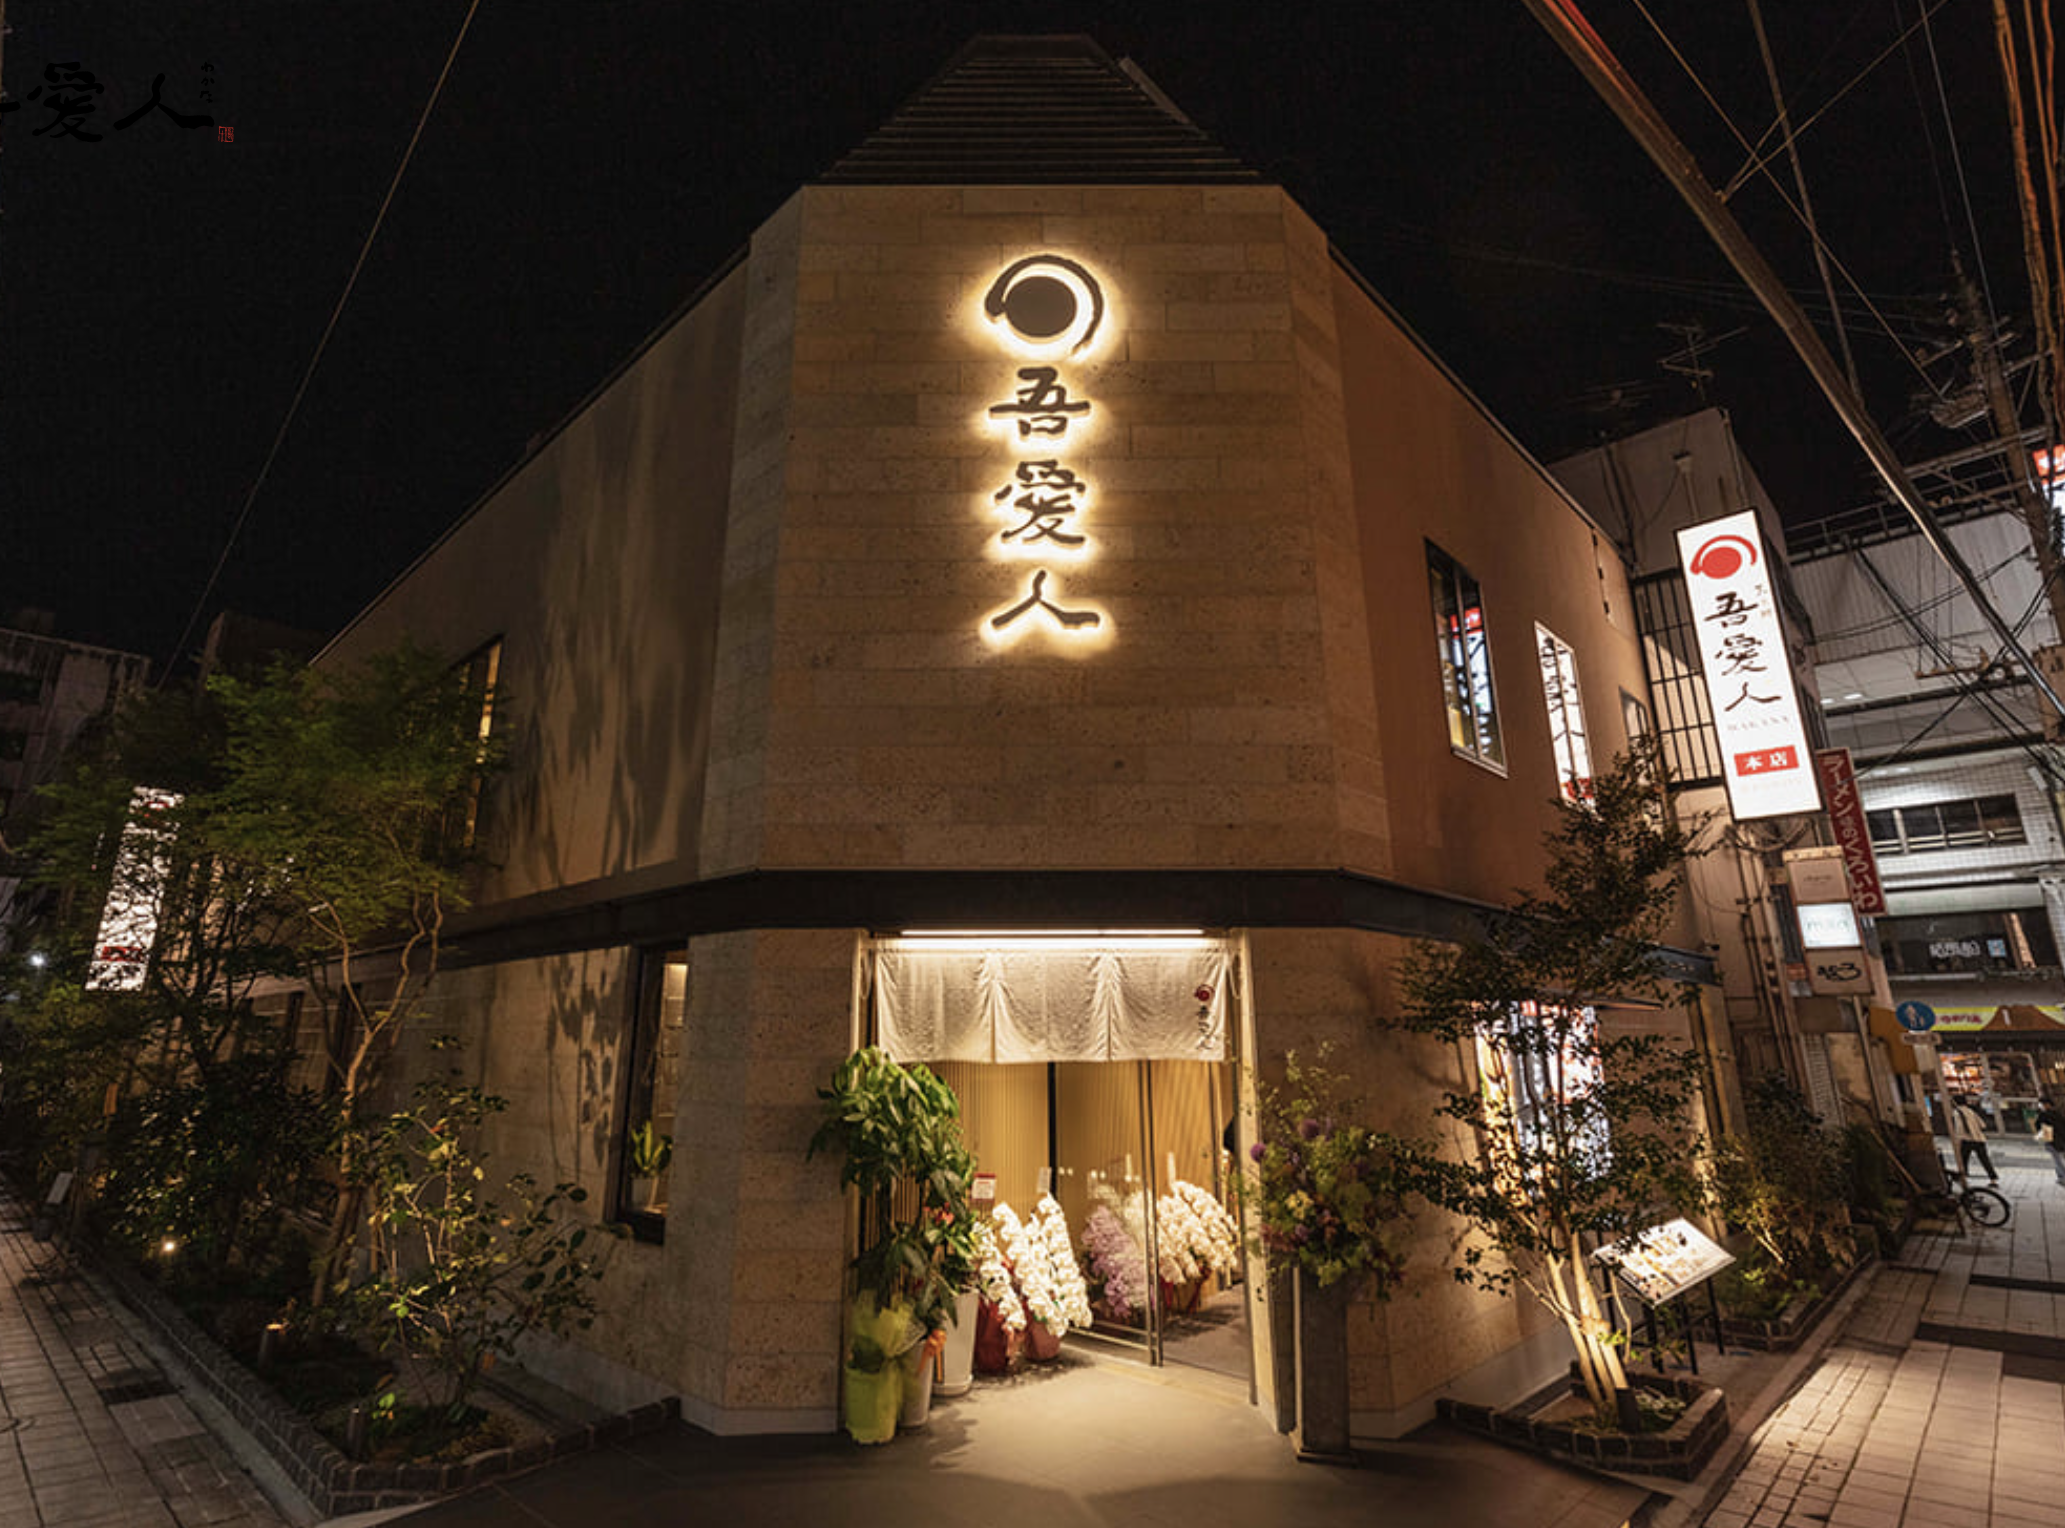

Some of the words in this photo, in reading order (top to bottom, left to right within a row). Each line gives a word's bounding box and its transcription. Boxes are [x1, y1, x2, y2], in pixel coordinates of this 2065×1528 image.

[988, 366, 1101, 630] 吾愛人
[1705, 591, 1781, 712] 吾愛人
[1744, 751, 1789, 772] 本店
